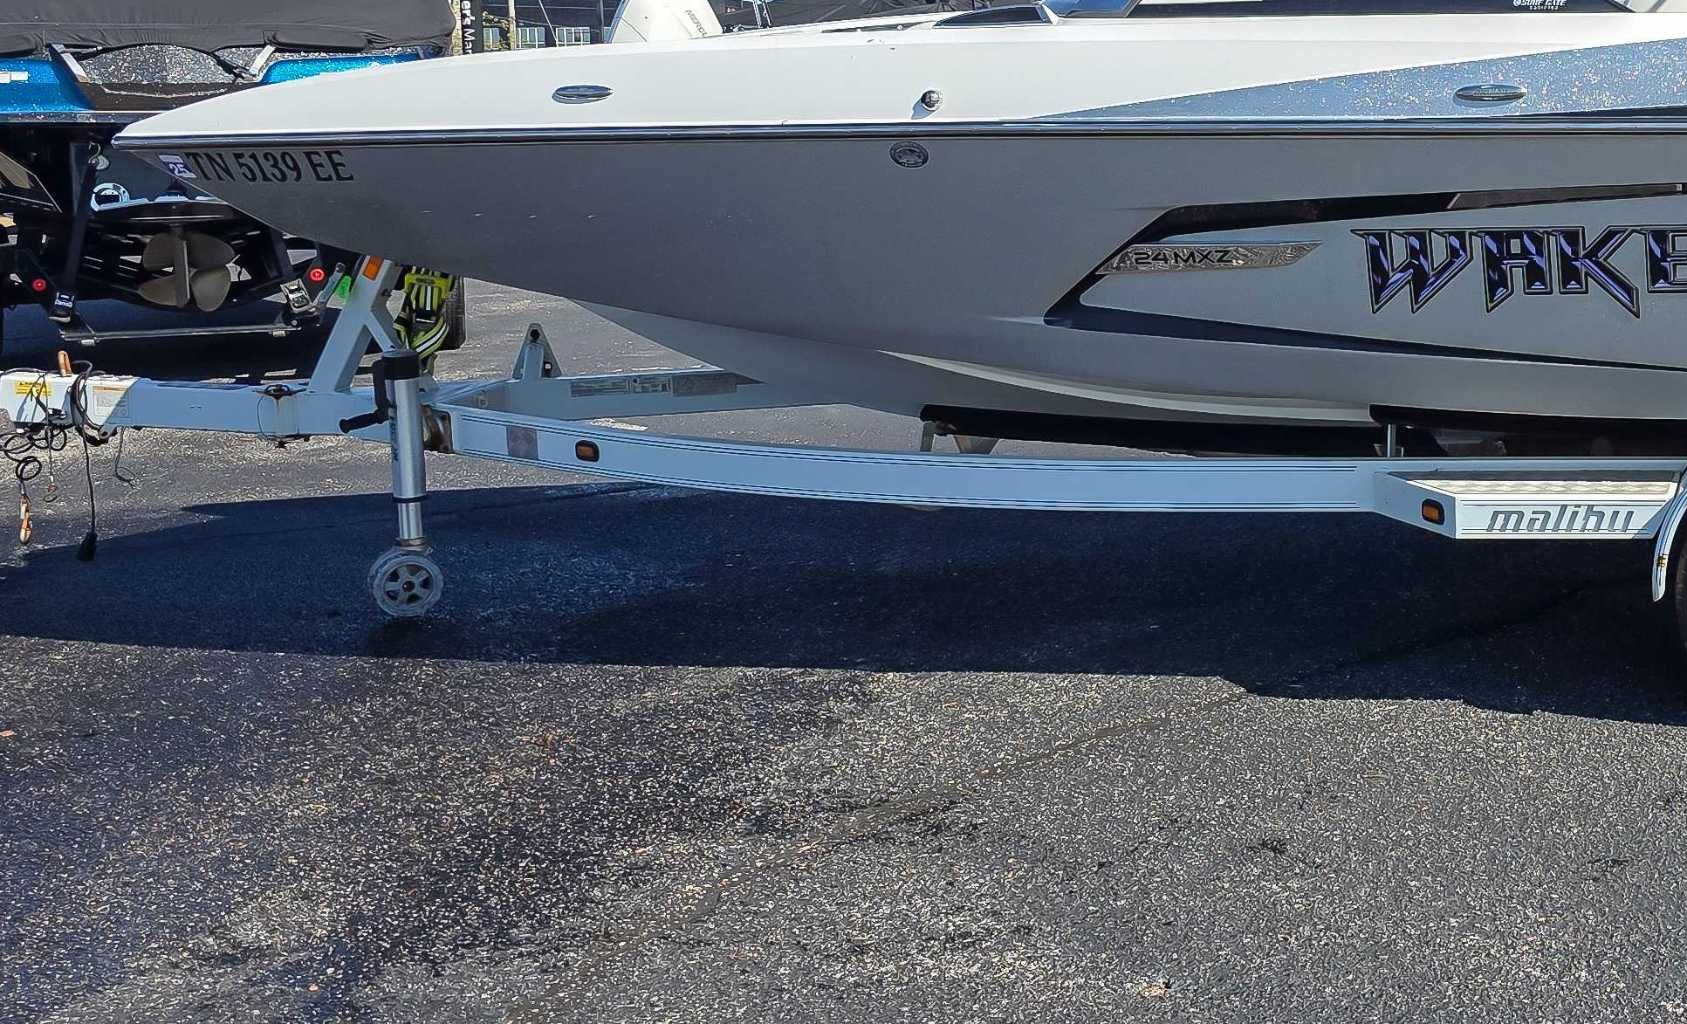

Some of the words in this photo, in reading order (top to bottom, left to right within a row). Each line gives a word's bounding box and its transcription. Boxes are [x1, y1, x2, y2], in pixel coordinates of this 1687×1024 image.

[169, 163, 187, 176] 25
[183, 152, 236, 182] TN
[234, 151, 303, 183] 5139
[303, 150, 354, 182] EE
[1487, 504, 1635, 533] malibu
